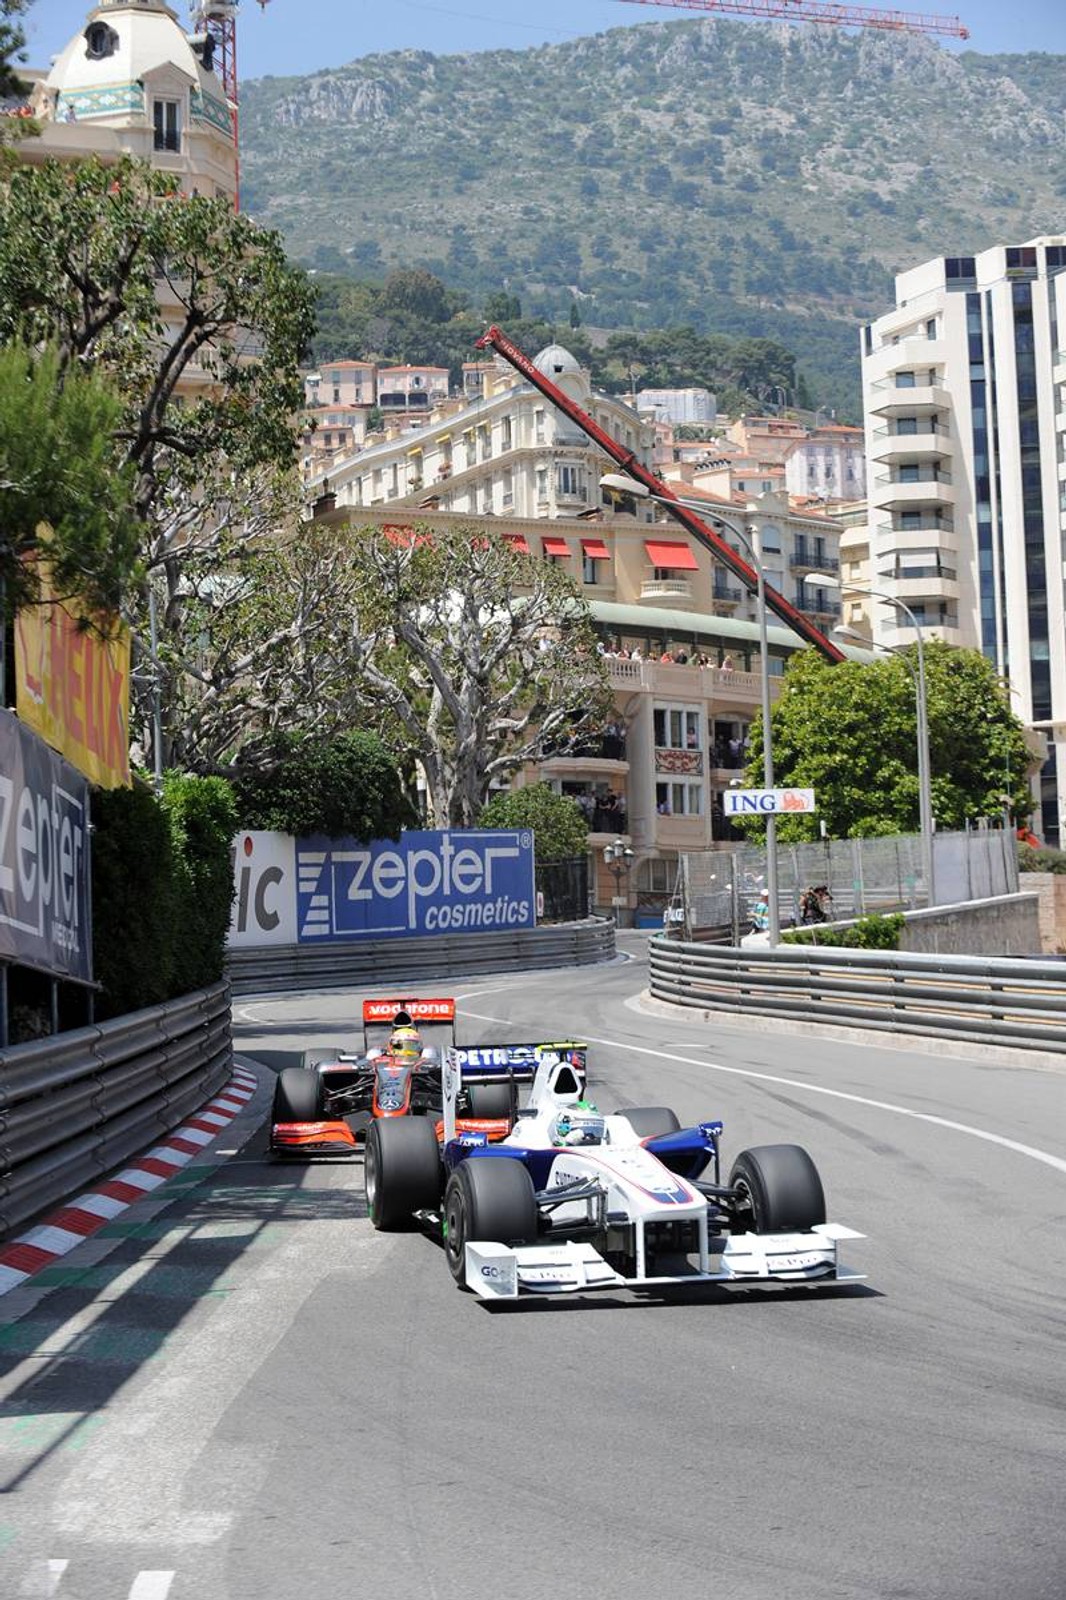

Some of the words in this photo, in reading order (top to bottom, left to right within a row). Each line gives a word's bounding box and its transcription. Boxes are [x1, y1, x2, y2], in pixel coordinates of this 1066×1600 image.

[50, 600, 129, 772] HELIX
[731, 794, 776, 812] ING
[331, 834, 519, 929] zepter
[425, 895, 529, 931] cosmetics
